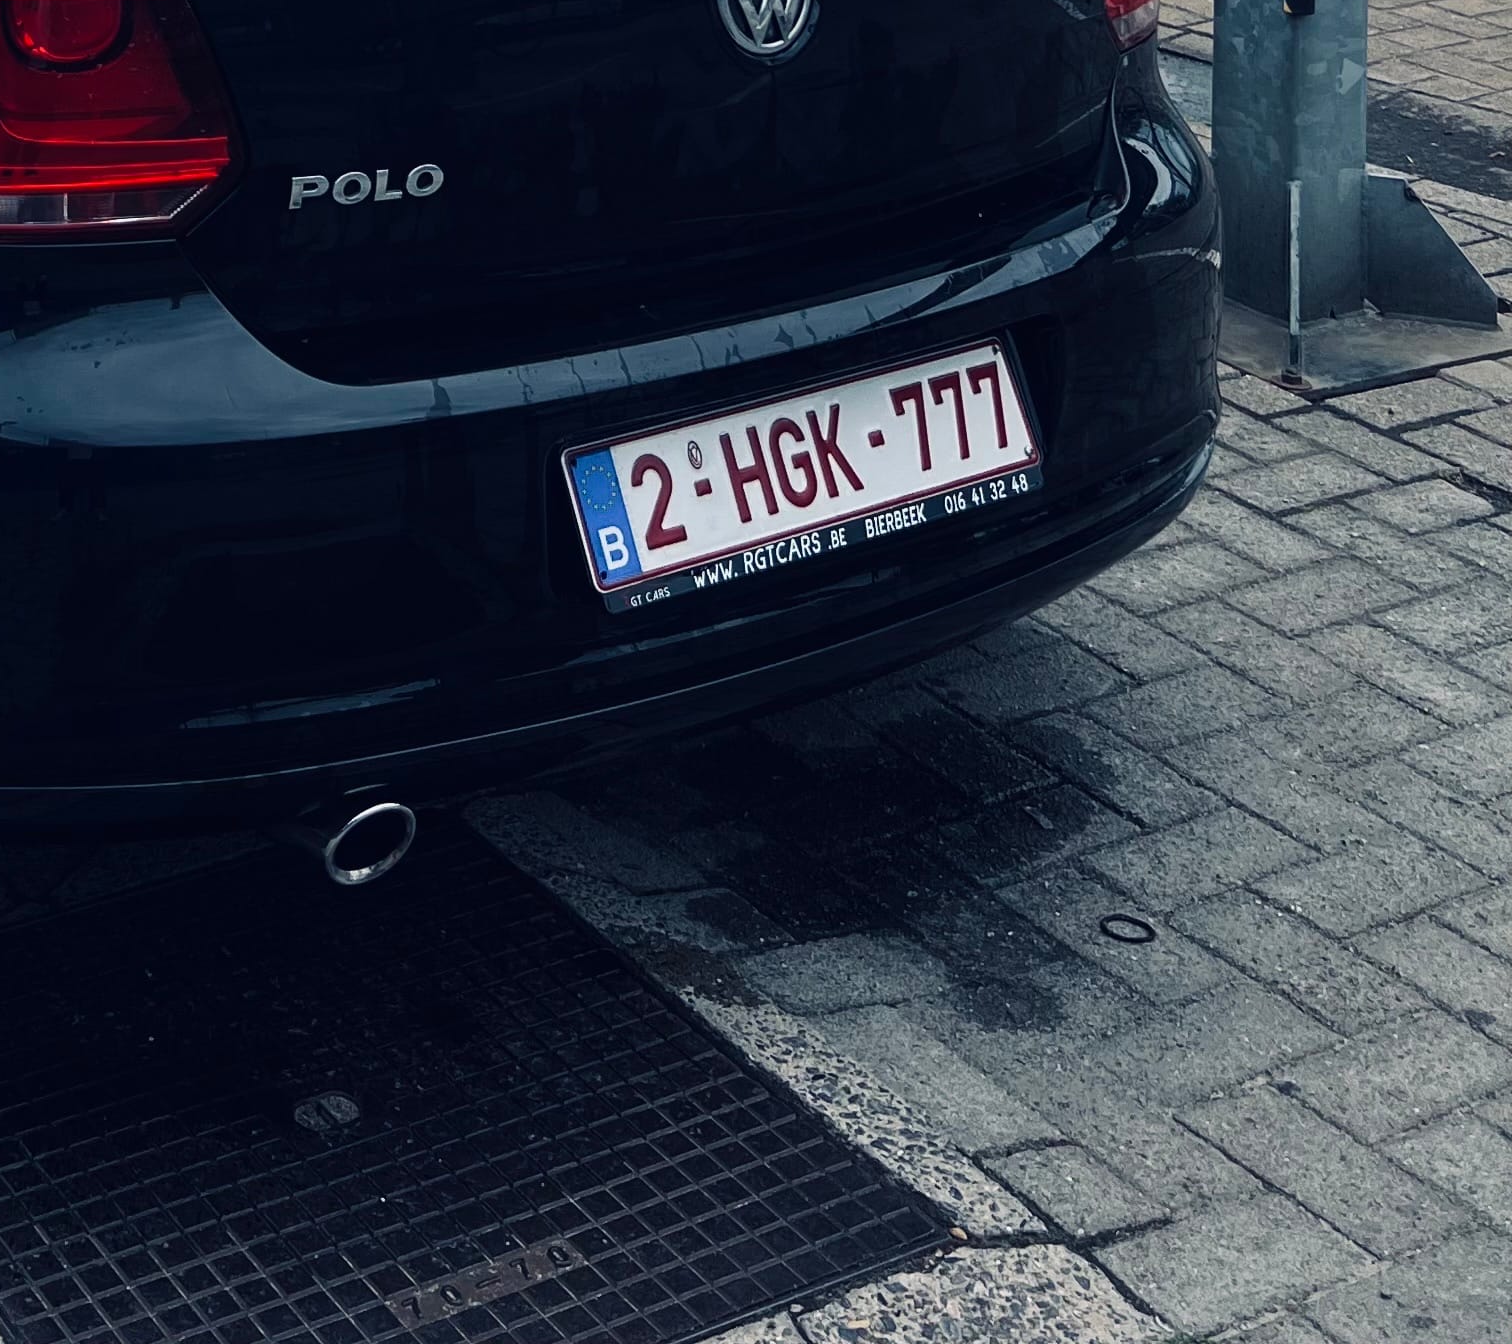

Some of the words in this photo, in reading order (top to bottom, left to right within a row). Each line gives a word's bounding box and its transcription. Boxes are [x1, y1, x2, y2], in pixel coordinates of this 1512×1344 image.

[289, 163, 444, 210] POLO
[598, 525, 629, 570] B
[691, 560, 738, 588] WWW.
[743, 531, 821, 574] RGTCARS
[865, 503, 927, 538] BIERBEEK
[944, 492, 966, 514] 016
[972, 486, 986, 506] 41
[989, 480, 1007, 500] 32
[1011, 473, 1028, 494] 48
[645, 586, 671, 603] CARS
